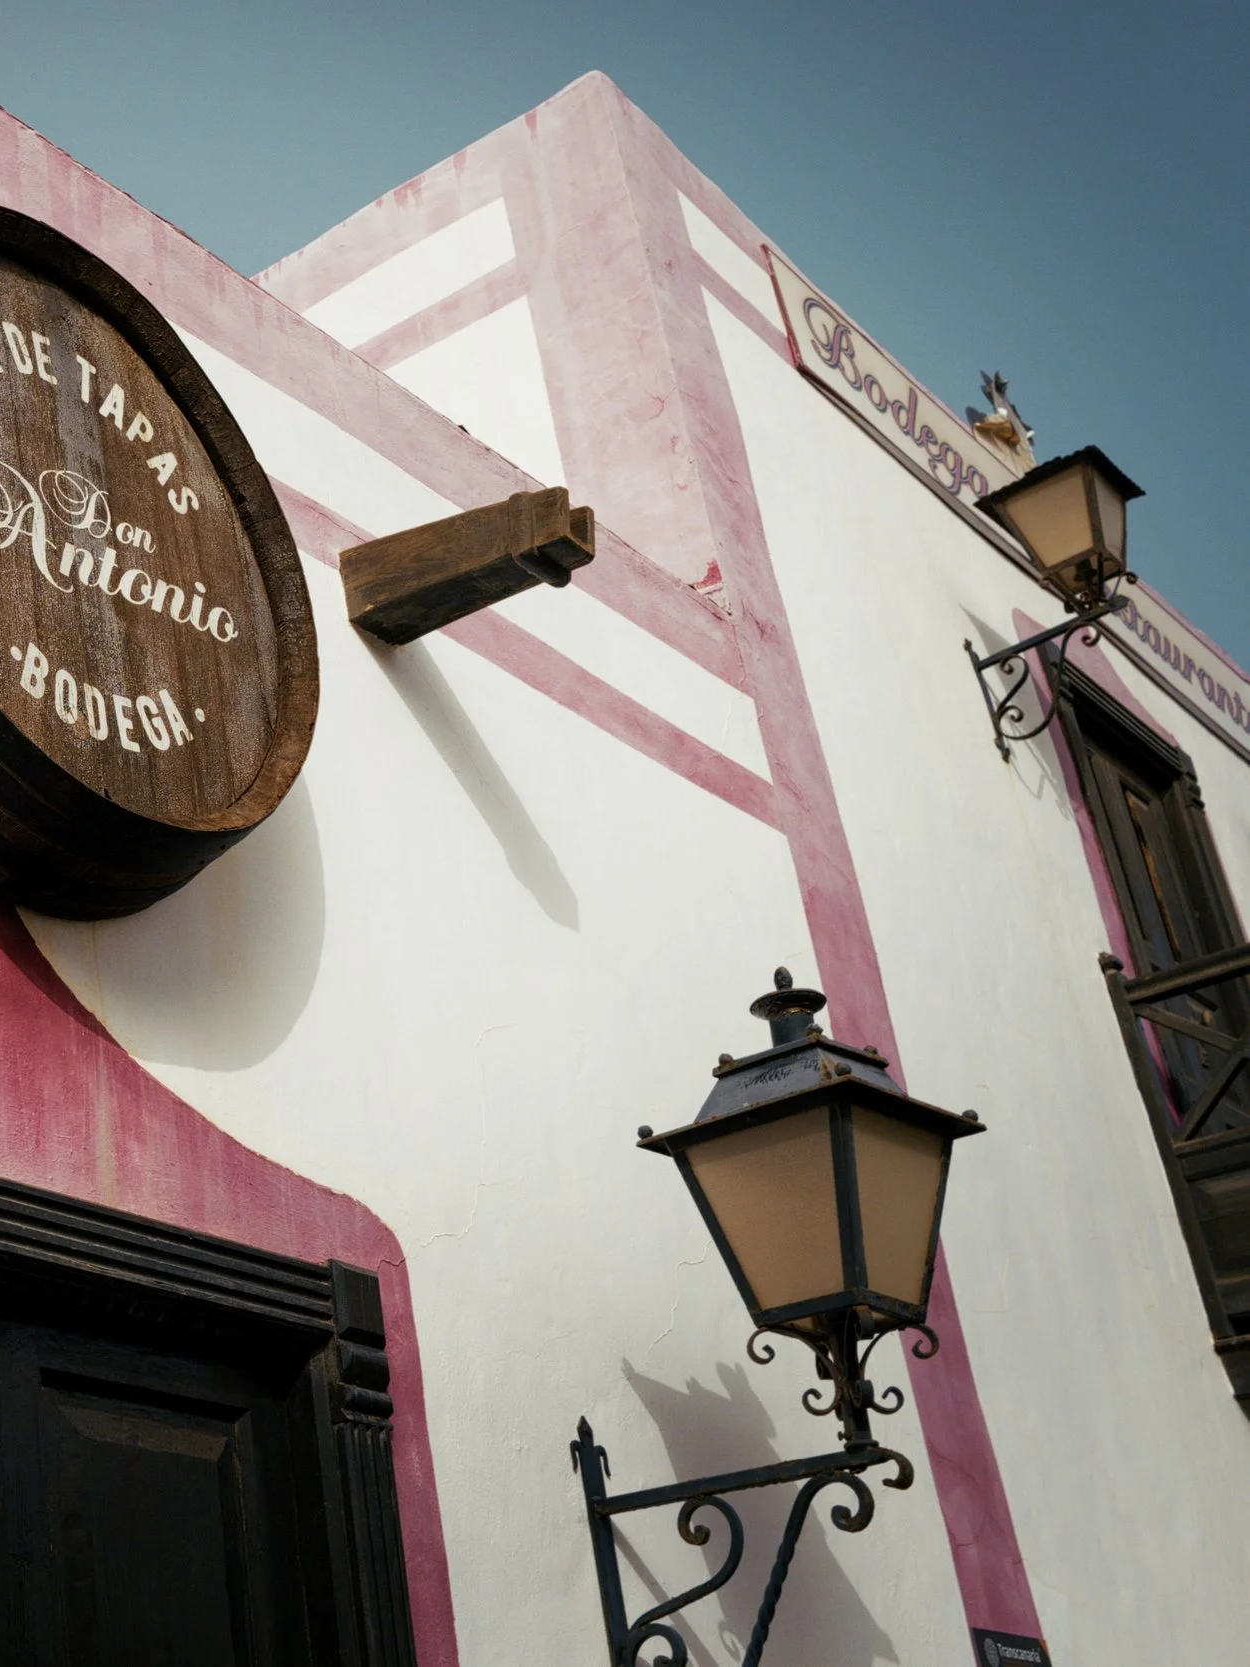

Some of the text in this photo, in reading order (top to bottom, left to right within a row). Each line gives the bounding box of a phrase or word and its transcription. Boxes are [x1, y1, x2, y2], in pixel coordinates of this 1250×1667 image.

[2, 321, 58, 386] DE
[76, 354, 199, 515] TAPAS
[803, 297, 989, 497] Bodega
[38, 469, 156, 554] Don
